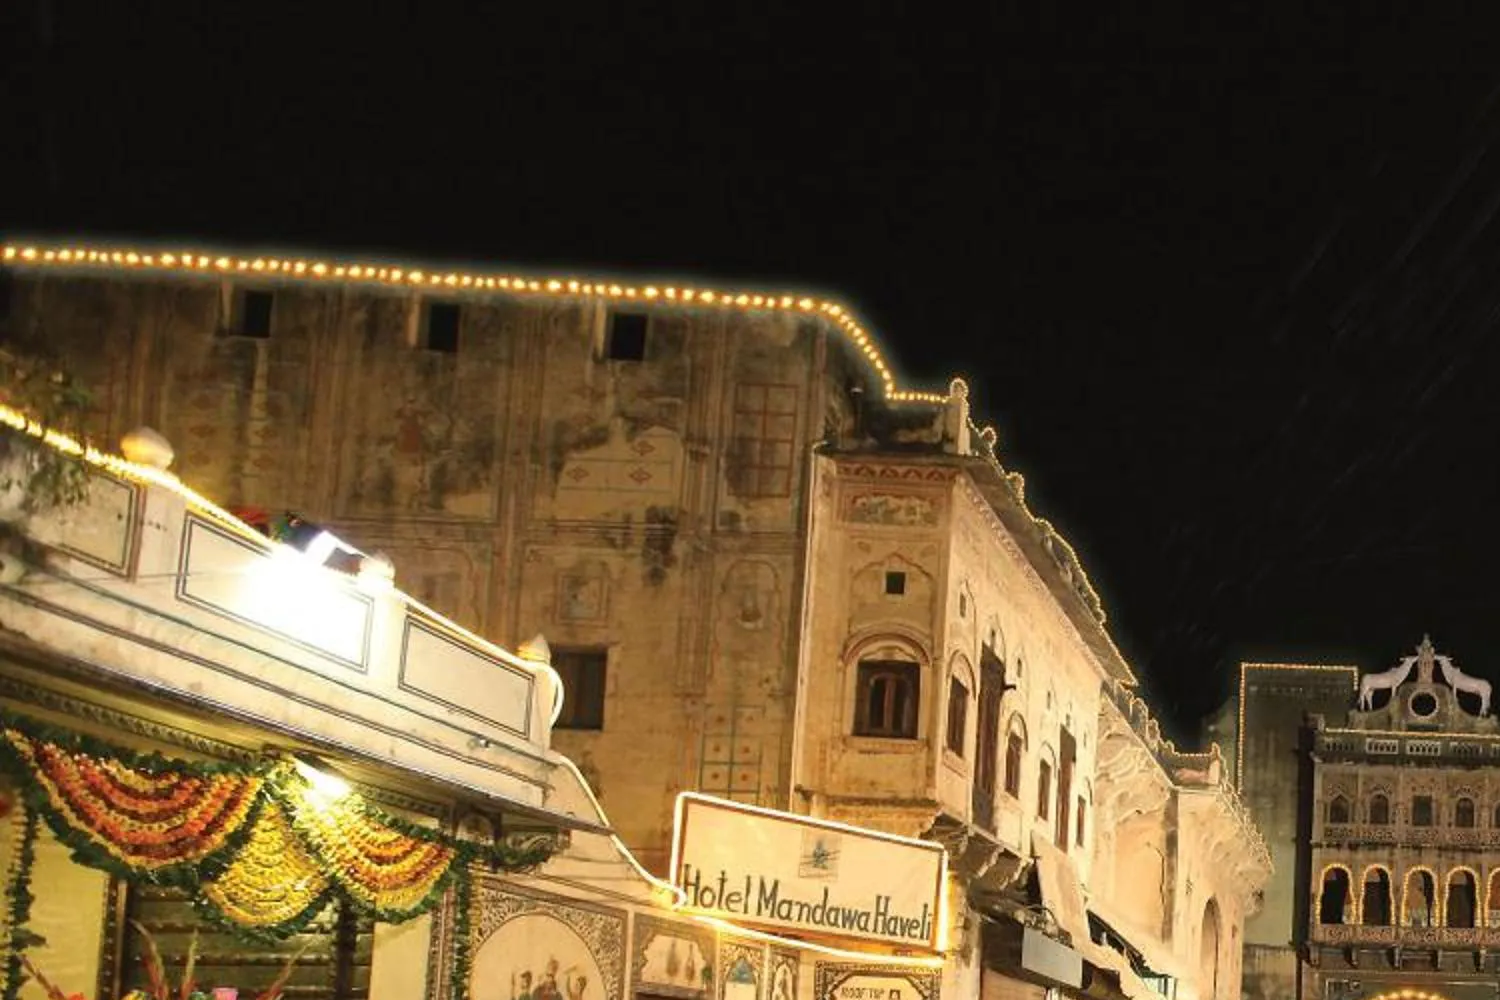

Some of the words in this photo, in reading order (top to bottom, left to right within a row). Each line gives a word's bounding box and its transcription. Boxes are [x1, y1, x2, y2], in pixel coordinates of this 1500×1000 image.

[684, 864, 751, 913] Hotel
[757, 878, 870, 932] Mandawa
[873, 894, 933, 941] Haveli
